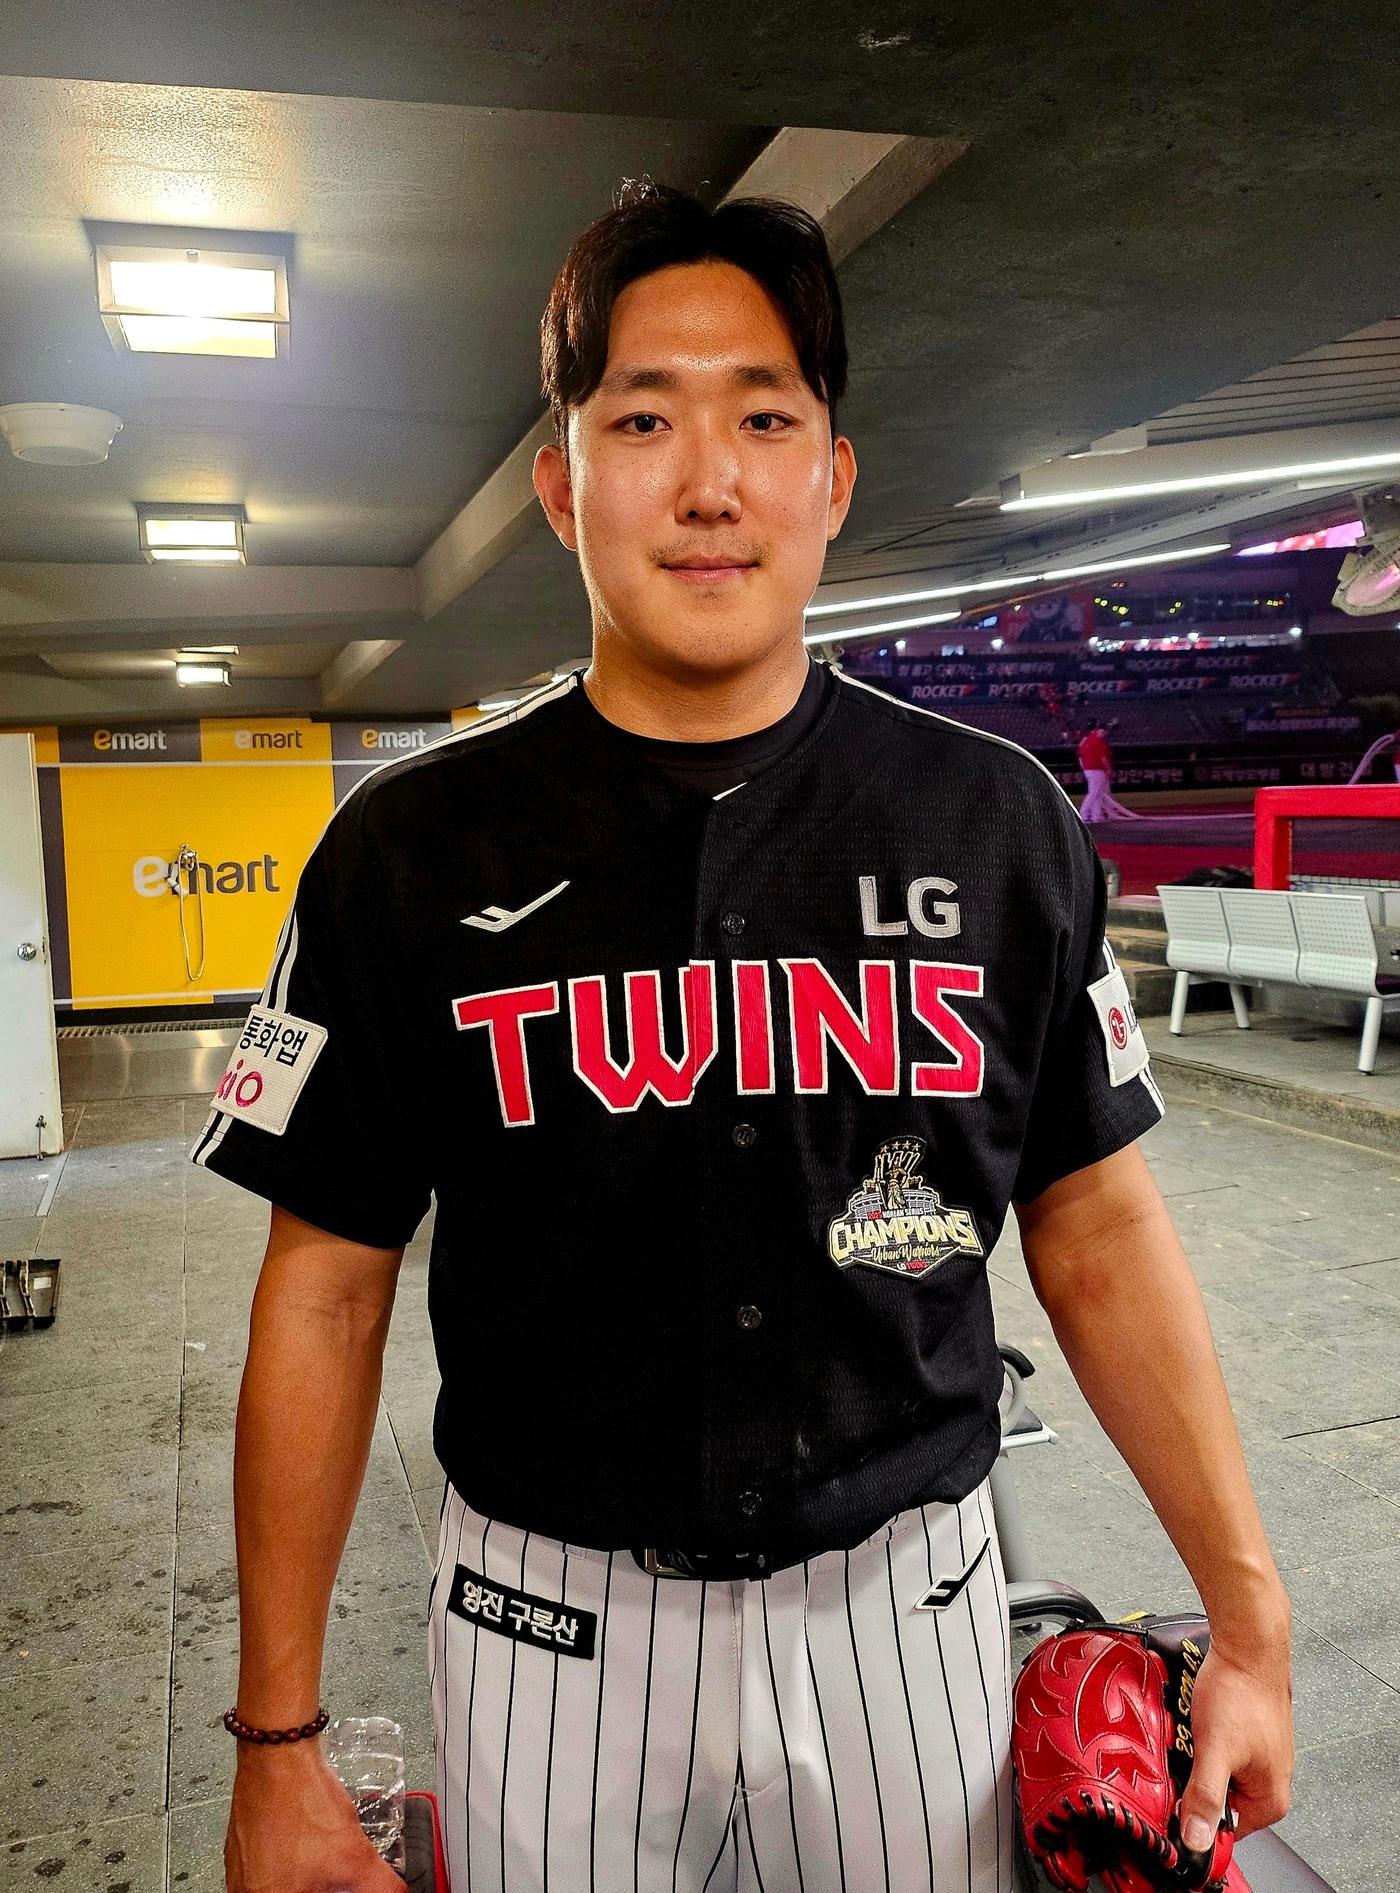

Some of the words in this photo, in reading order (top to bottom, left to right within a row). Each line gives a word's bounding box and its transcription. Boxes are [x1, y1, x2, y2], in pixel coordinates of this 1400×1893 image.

[911, 683, 967, 699] ROCKET
[1146, 676, 1206, 692] ROCKET
[1229, 673, 1289, 688] ROCKET
[93, 729, 167, 750] emart
[234, 729, 303, 749] emart
[361, 728, 427, 749] emart
[858, 875, 961, 939] LG
[240, 1015, 309, 1067] 통화앱
[451, 957, 985, 1128] TWINS
[831, 1212, 978, 1260] CHAMPIONS
[871, 1246, 901, 1264] Urban
[462, 1580, 505, 1624] 영진
[507, 1599, 579, 1647] 구론산
